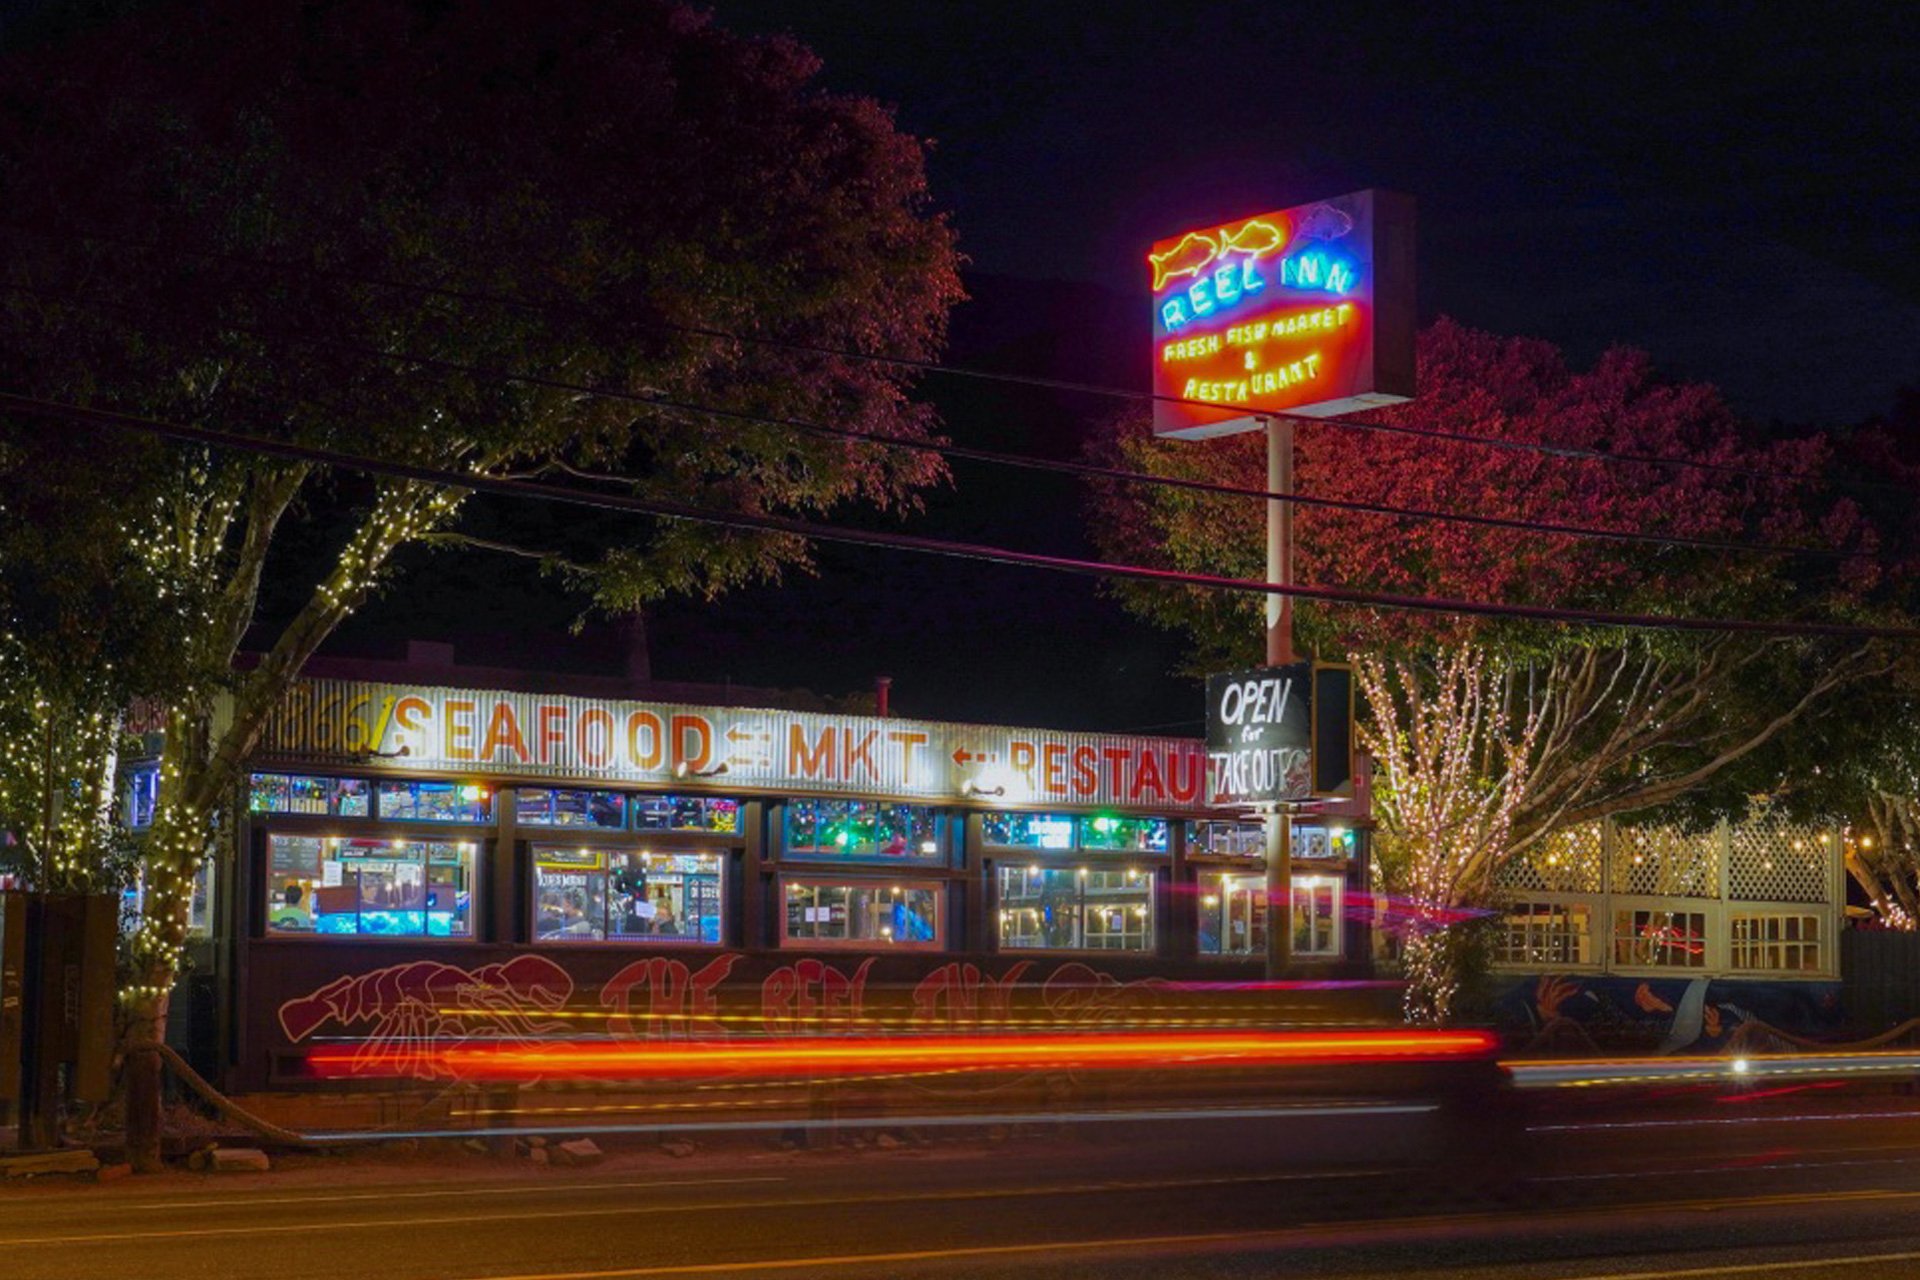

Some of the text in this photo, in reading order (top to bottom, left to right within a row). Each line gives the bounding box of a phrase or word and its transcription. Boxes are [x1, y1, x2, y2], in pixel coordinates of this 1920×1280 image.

[1162, 253, 1351, 332] REEL INN
[1163, 303, 1352, 362] FRESH FISH MARKET
[1243, 350, 1257, 371] &
[1220, 678, 1292, 725] OPEN
[395, 696, 713, 773] SEAFOOD
[789, 723, 928, 784] MKT
[1010, 741, 1207, 802] RESTAU
[1240, 726, 1265, 744] for
[1209, 749, 1249, 796] TAKE
[601, 953, 743, 1046] THE
[761, 957, 880, 1040] REEL
